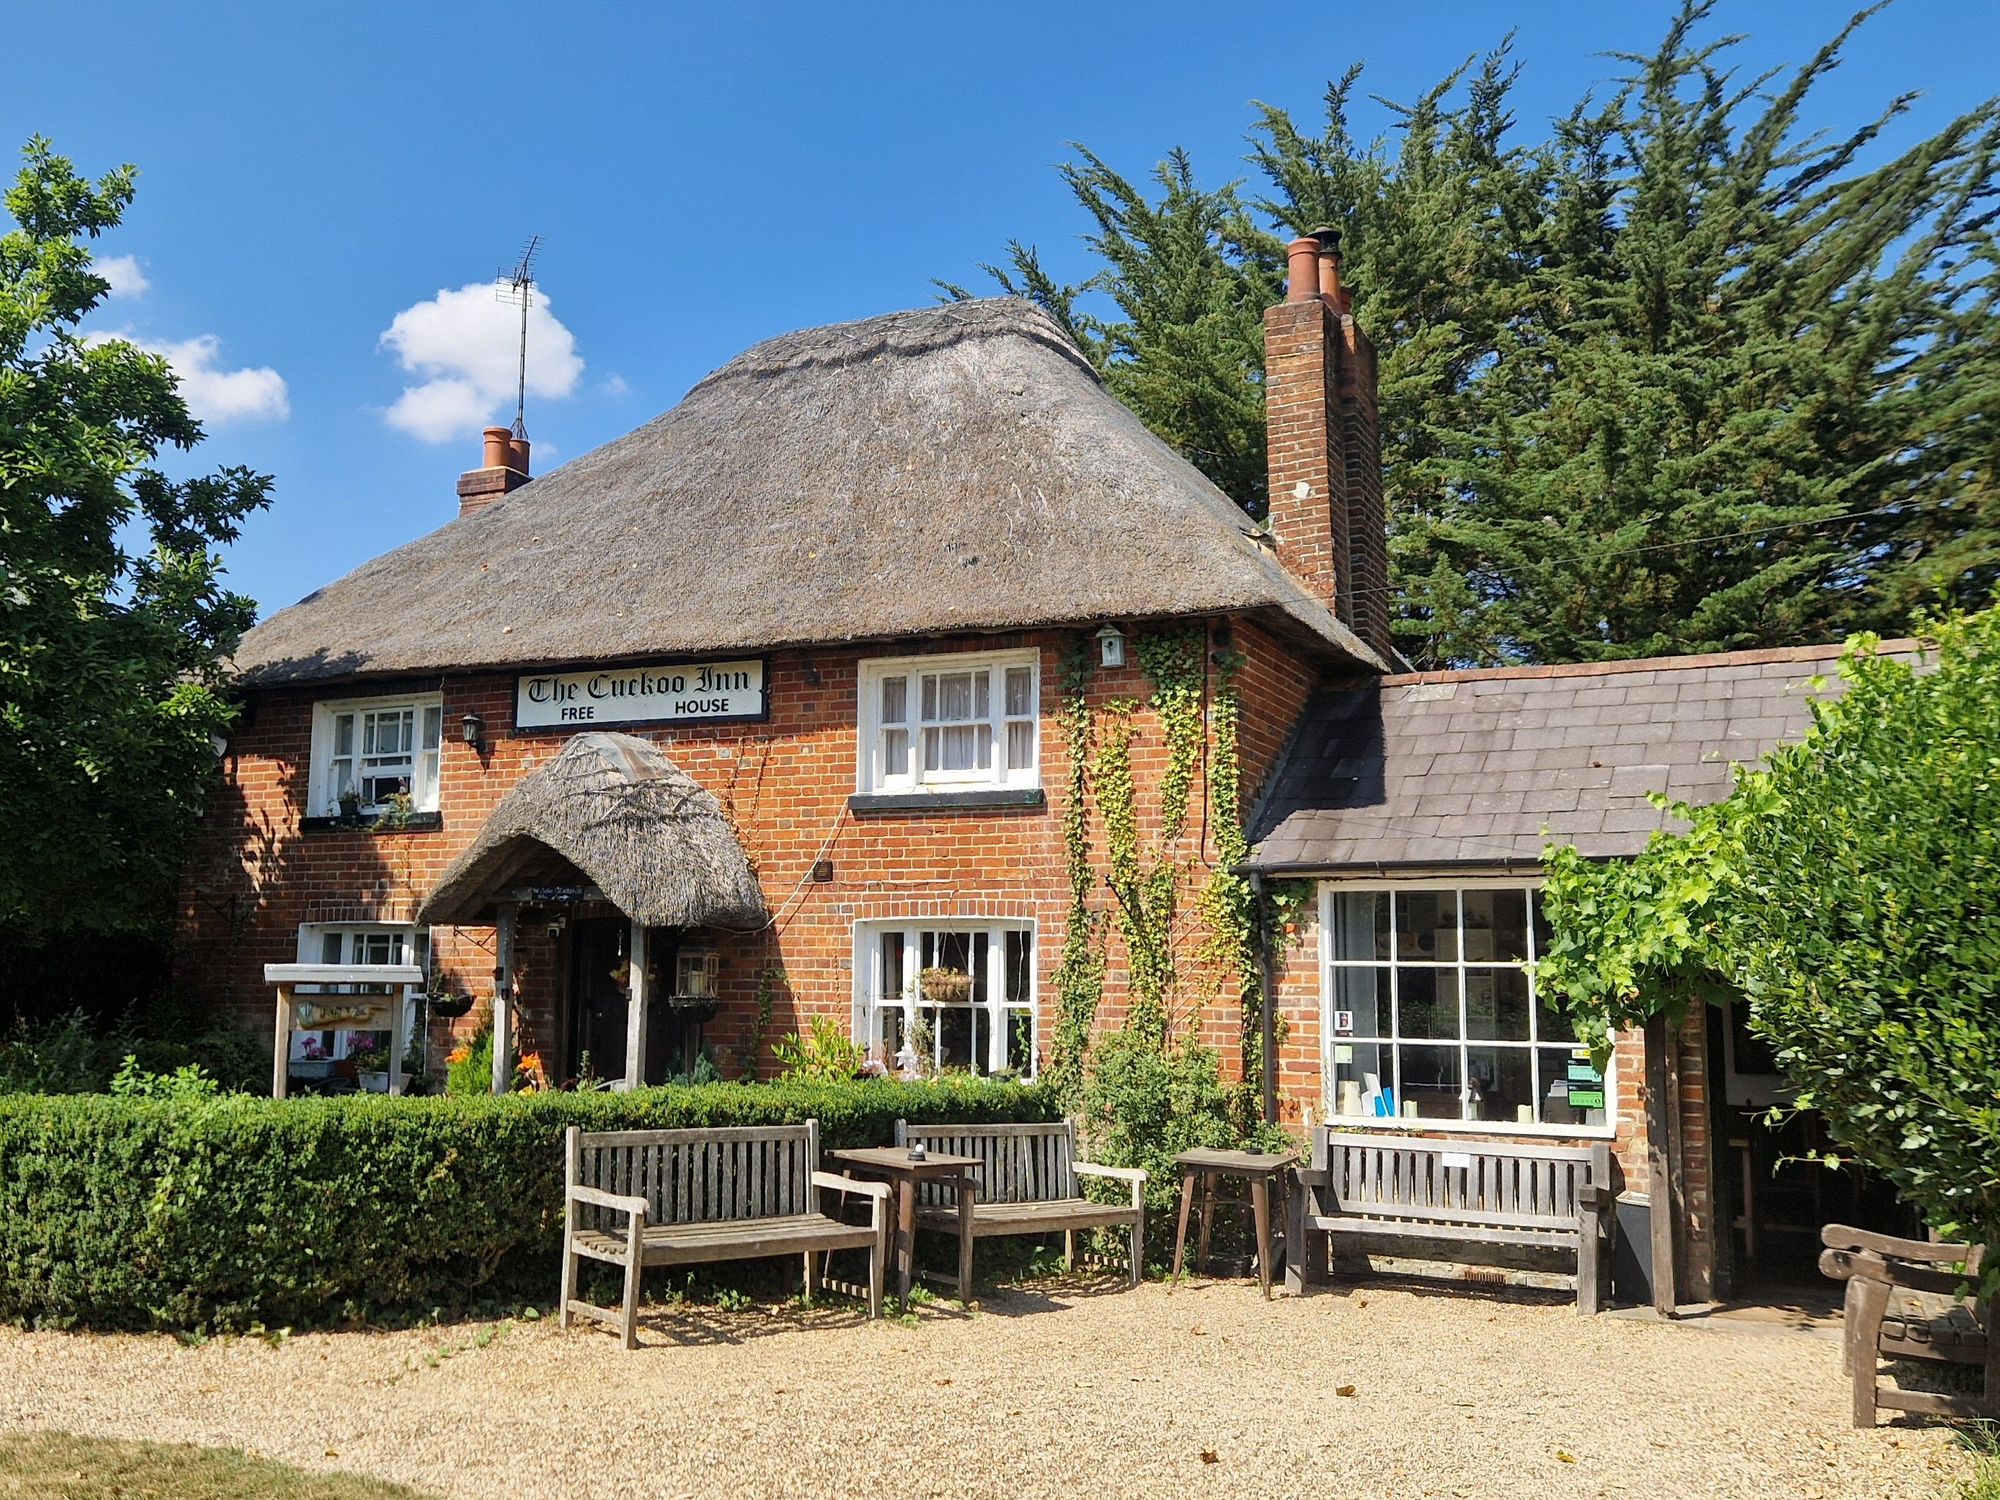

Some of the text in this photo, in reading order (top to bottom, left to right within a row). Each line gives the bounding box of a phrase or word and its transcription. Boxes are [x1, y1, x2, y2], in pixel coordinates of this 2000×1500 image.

[528, 665, 750, 705] The Cuckoo Inn
[561, 698, 729, 720] FREE HOUSE
